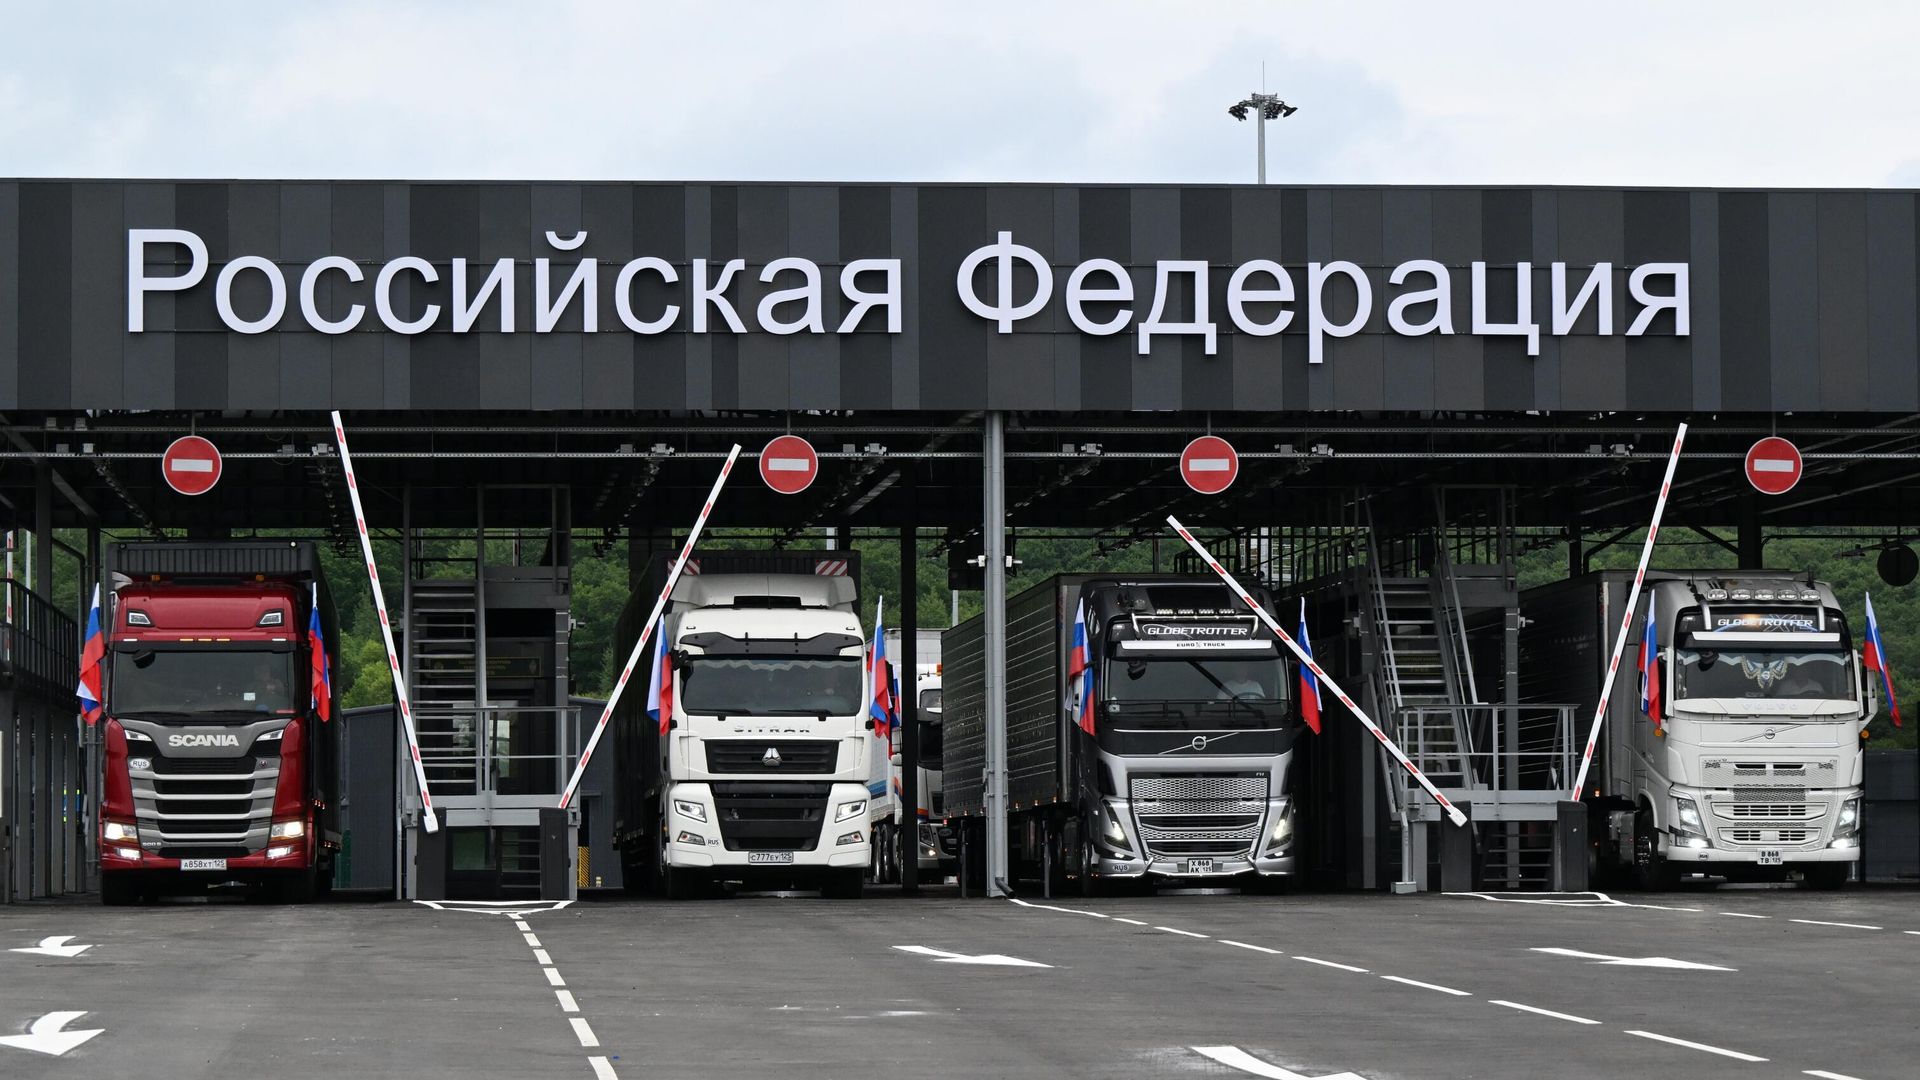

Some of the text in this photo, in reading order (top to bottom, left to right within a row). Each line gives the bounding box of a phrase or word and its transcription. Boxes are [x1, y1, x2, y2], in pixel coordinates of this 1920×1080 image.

[128, 229, 1690, 364] Российская Федерация
[1147, 627, 1248, 635] GLOBETROTTER
[168, 734, 240, 747] SCANIA
[132, 760, 148, 768] RUS
